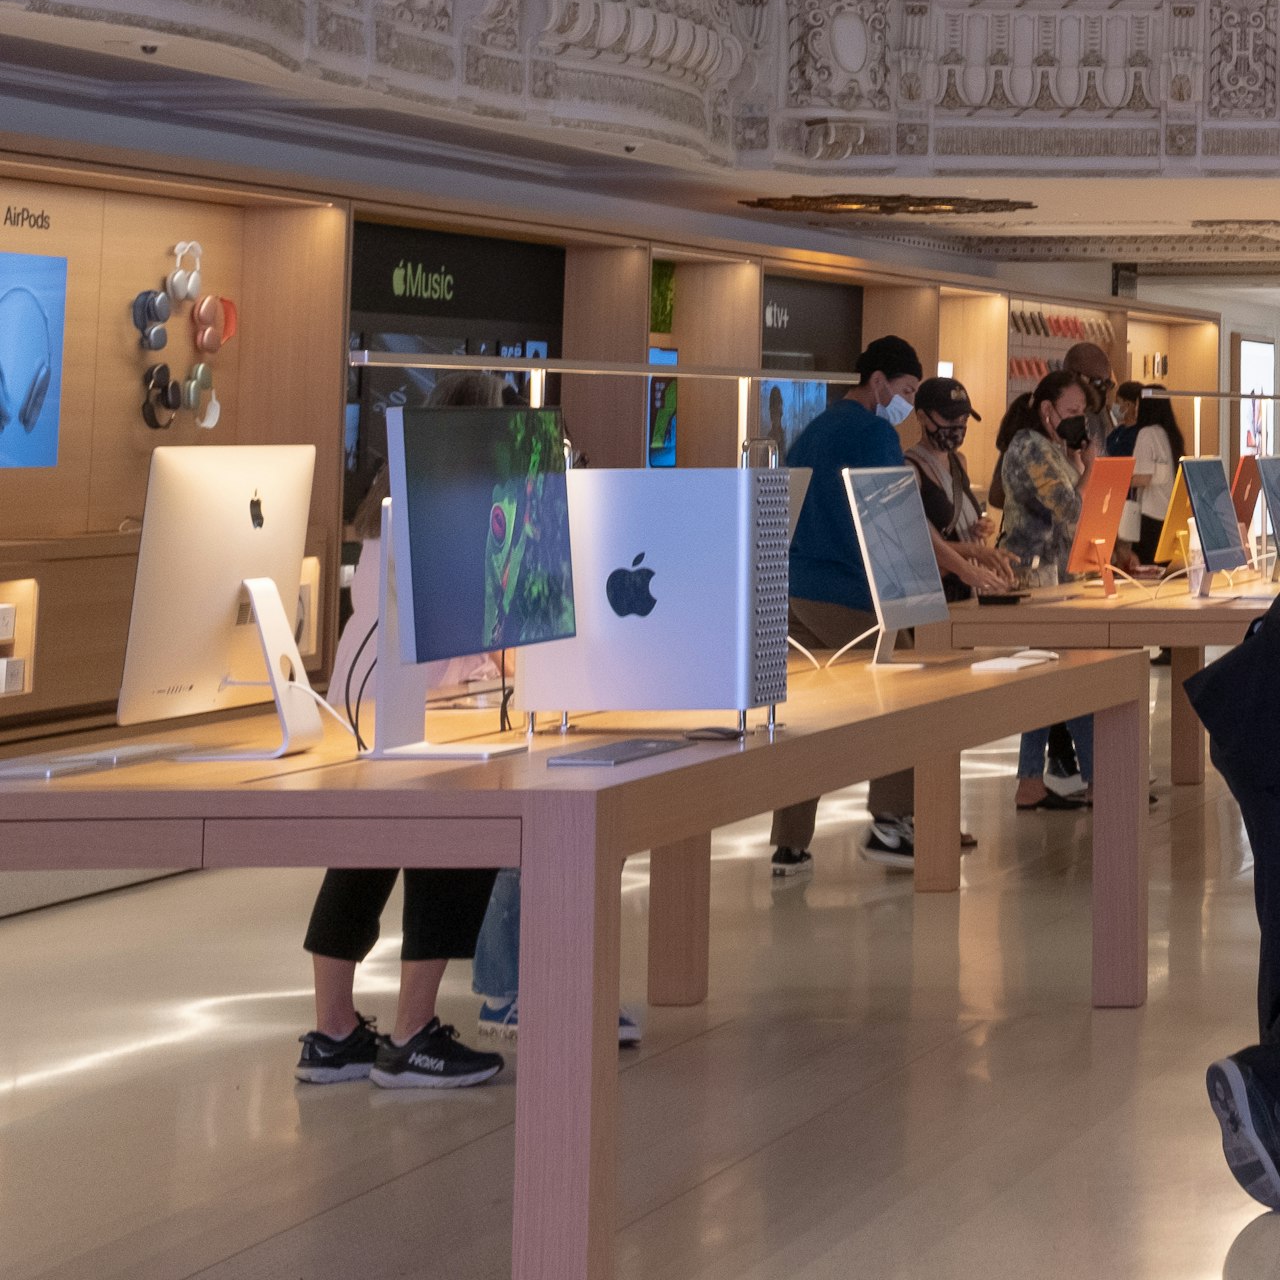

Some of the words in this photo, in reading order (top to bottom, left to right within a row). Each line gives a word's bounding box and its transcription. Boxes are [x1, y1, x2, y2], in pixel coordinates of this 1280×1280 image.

[3, 205, 50, 230] AirPods
[406, 261, 454, 301] Music
[408, 1051, 445, 1072] HOKA
